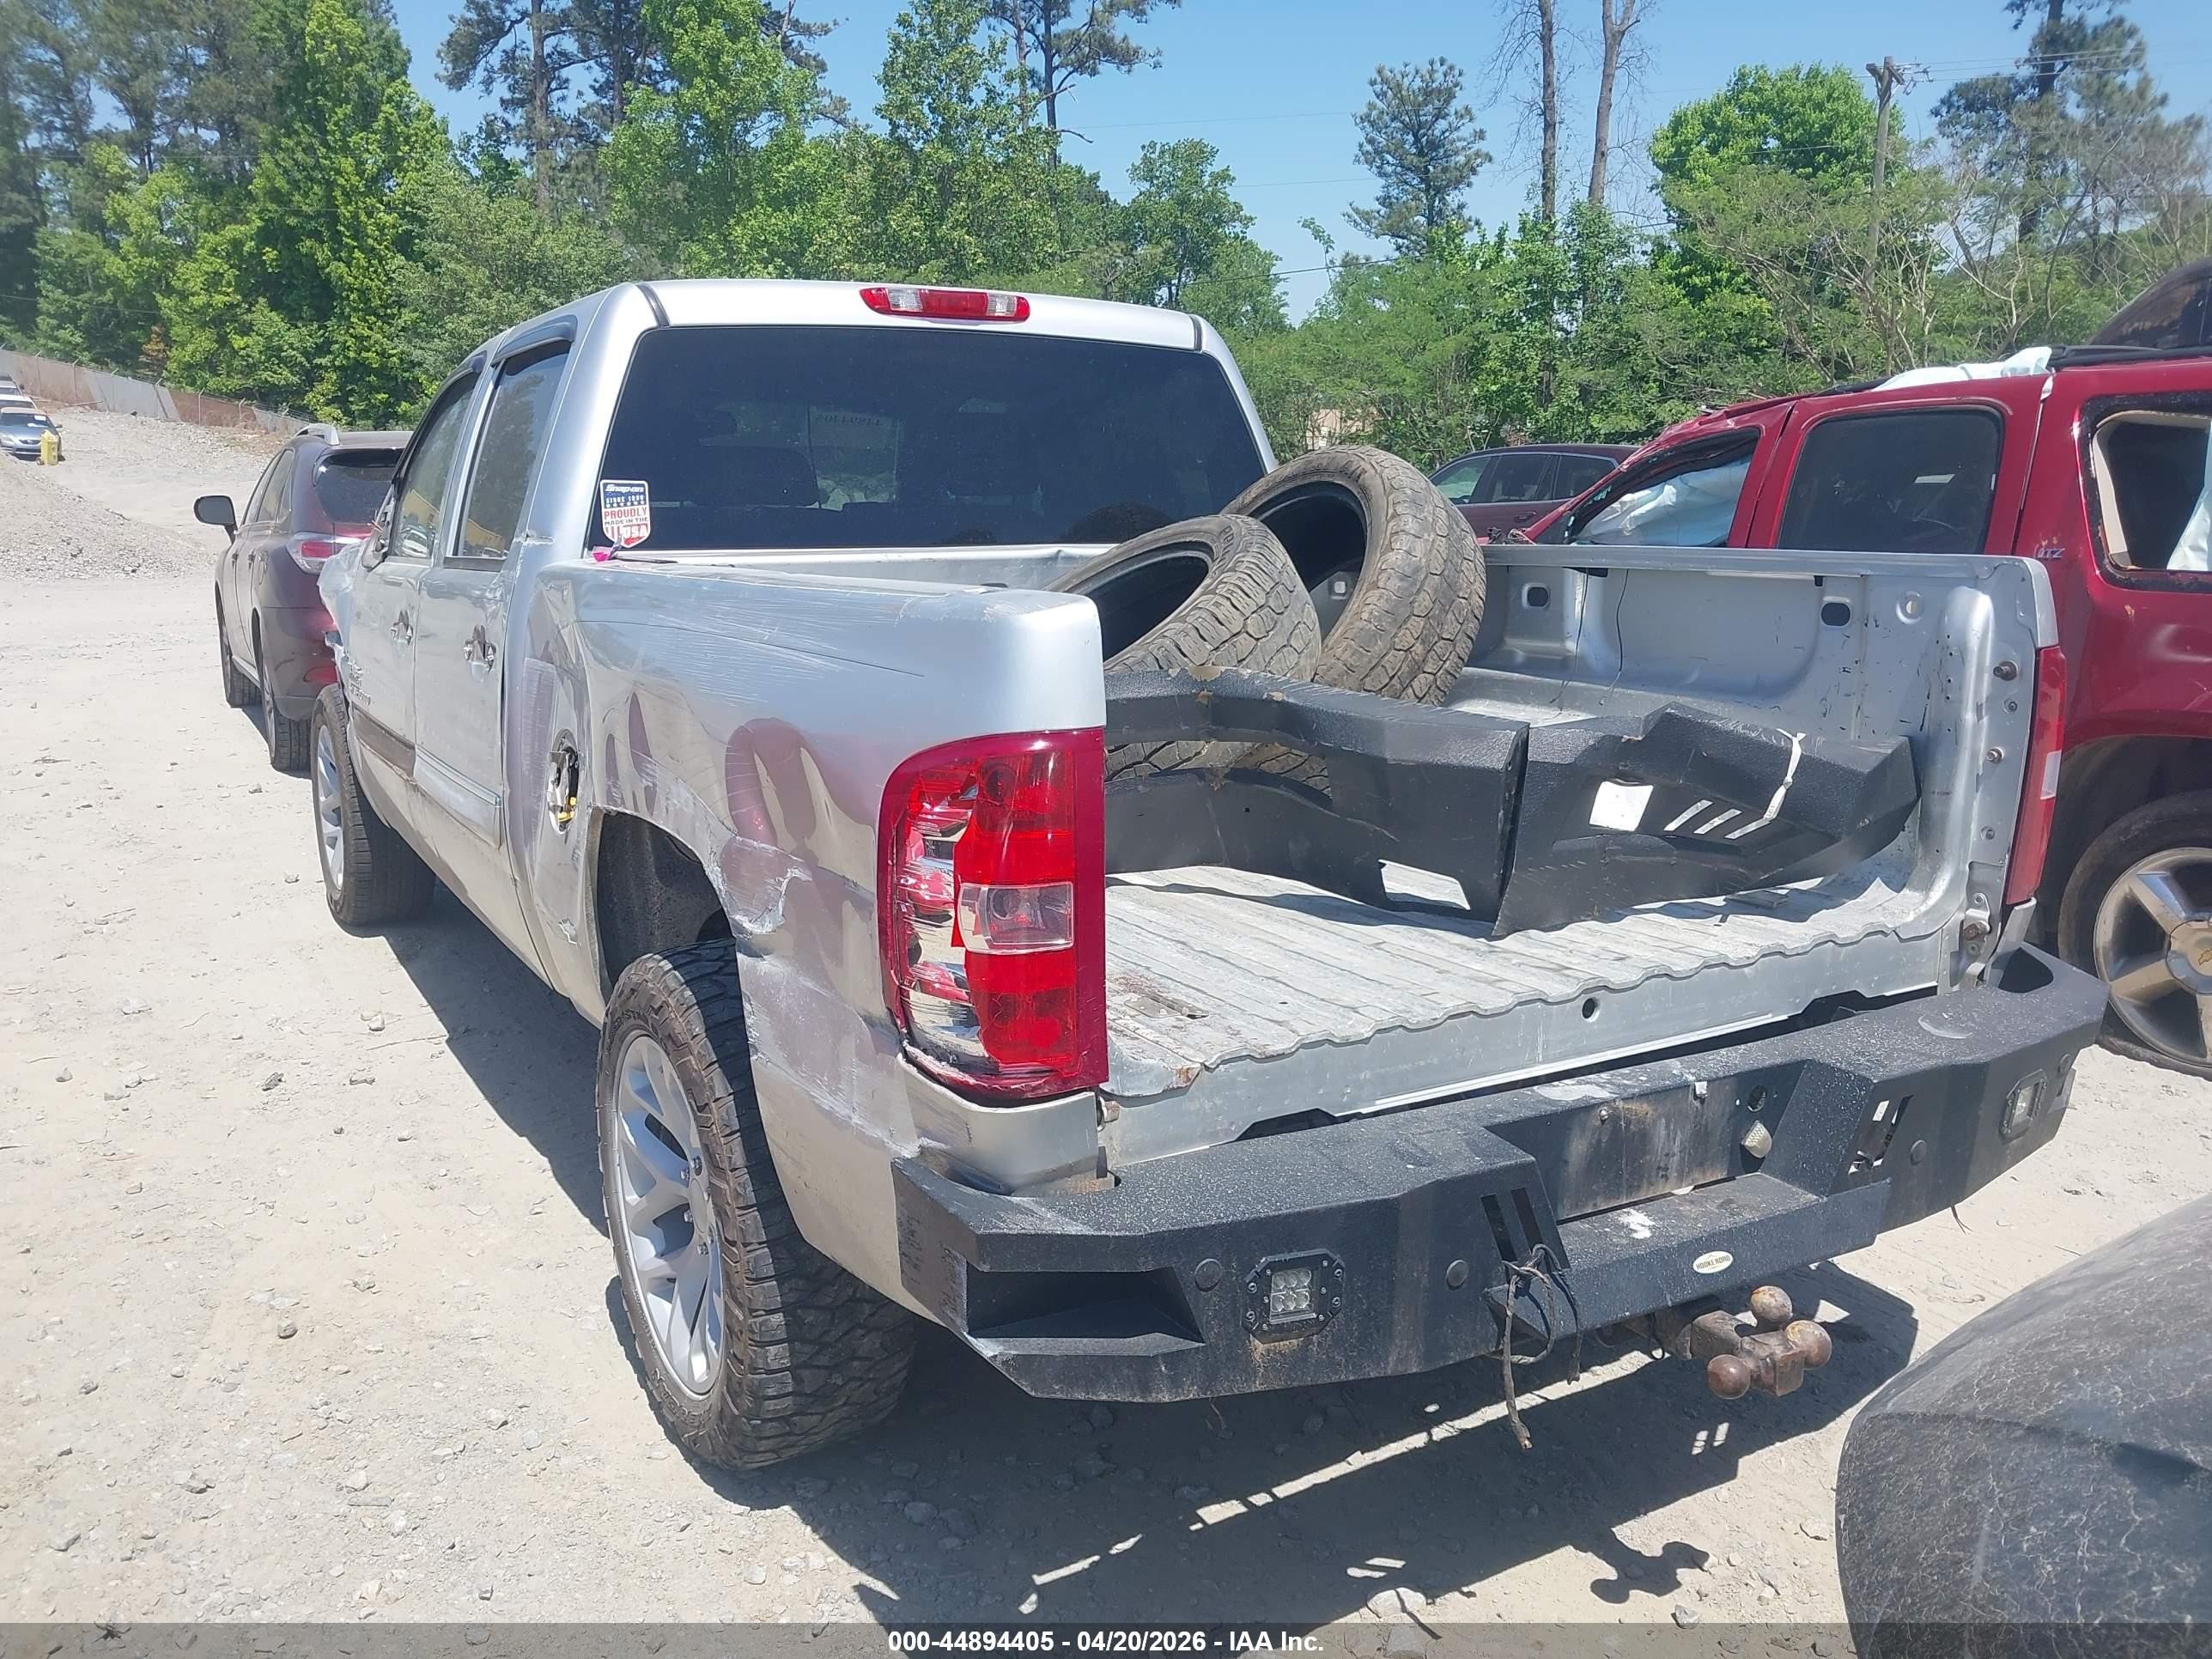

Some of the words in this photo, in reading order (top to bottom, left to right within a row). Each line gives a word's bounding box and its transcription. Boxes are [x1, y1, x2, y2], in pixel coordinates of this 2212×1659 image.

[605, 484, 644, 493] Snap-on
[604, 507, 647, 520] PROUDLY
[605, 518, 624, 526] MADE
[621, 525, 648, 538] USA
[1696, 1260, 1715, 1270] HOOKE
[1715, 1255, 1731, 1264] ROAD
